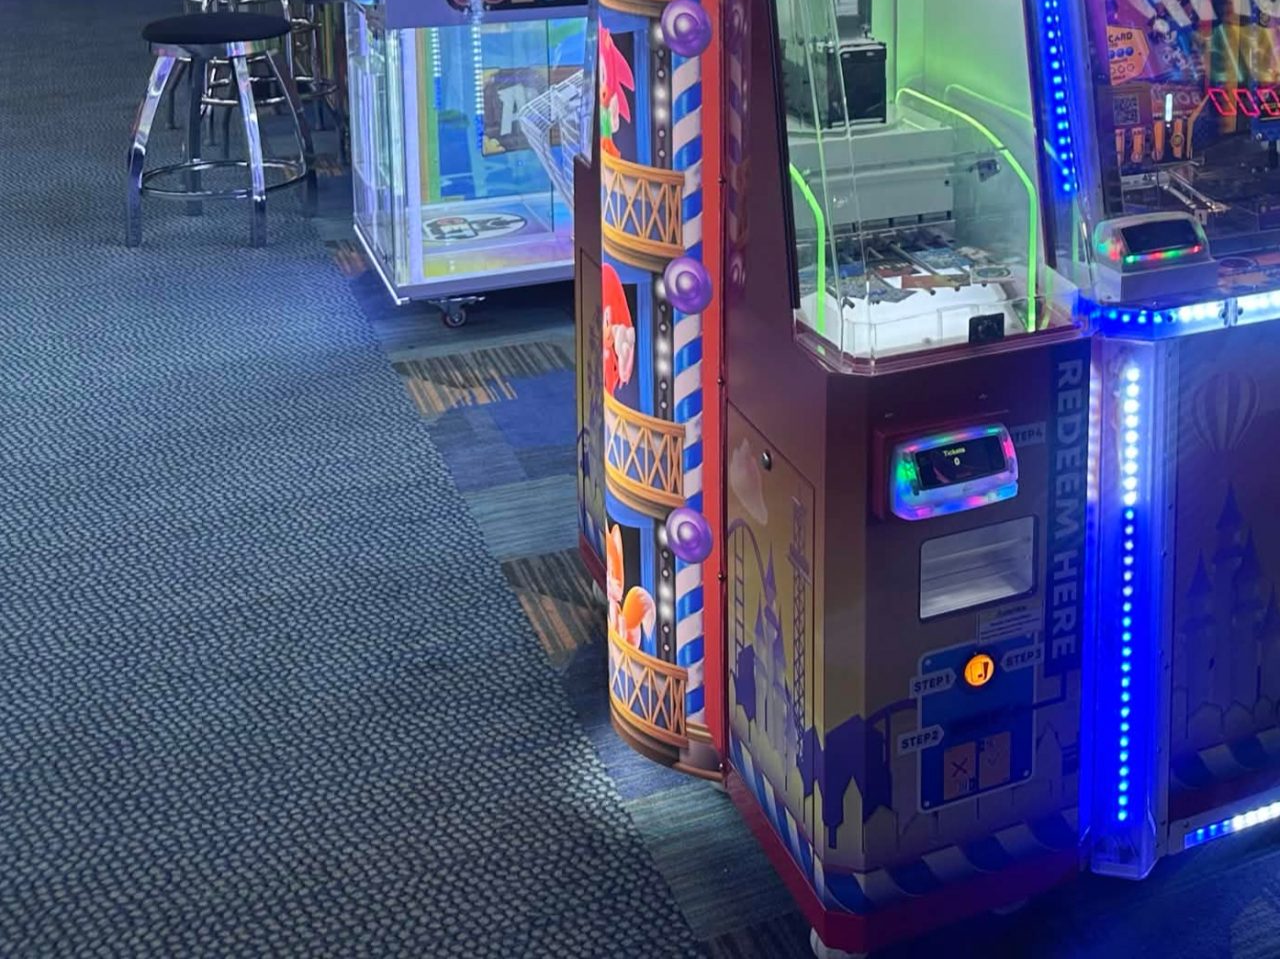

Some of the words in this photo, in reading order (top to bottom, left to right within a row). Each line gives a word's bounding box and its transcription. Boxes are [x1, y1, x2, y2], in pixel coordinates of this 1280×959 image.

[1109, 31, 1133, 44] CARD
[1055, 359, 1083, 539] REDEEM
[954, 457, 960, 466] 0
[1051, 550, 1079, 660] HERE
[1005, 648, 1042, 668] STEP3
[914, 674, 950, 692] STEP1
[901, 730, 940, 750] STEP2
